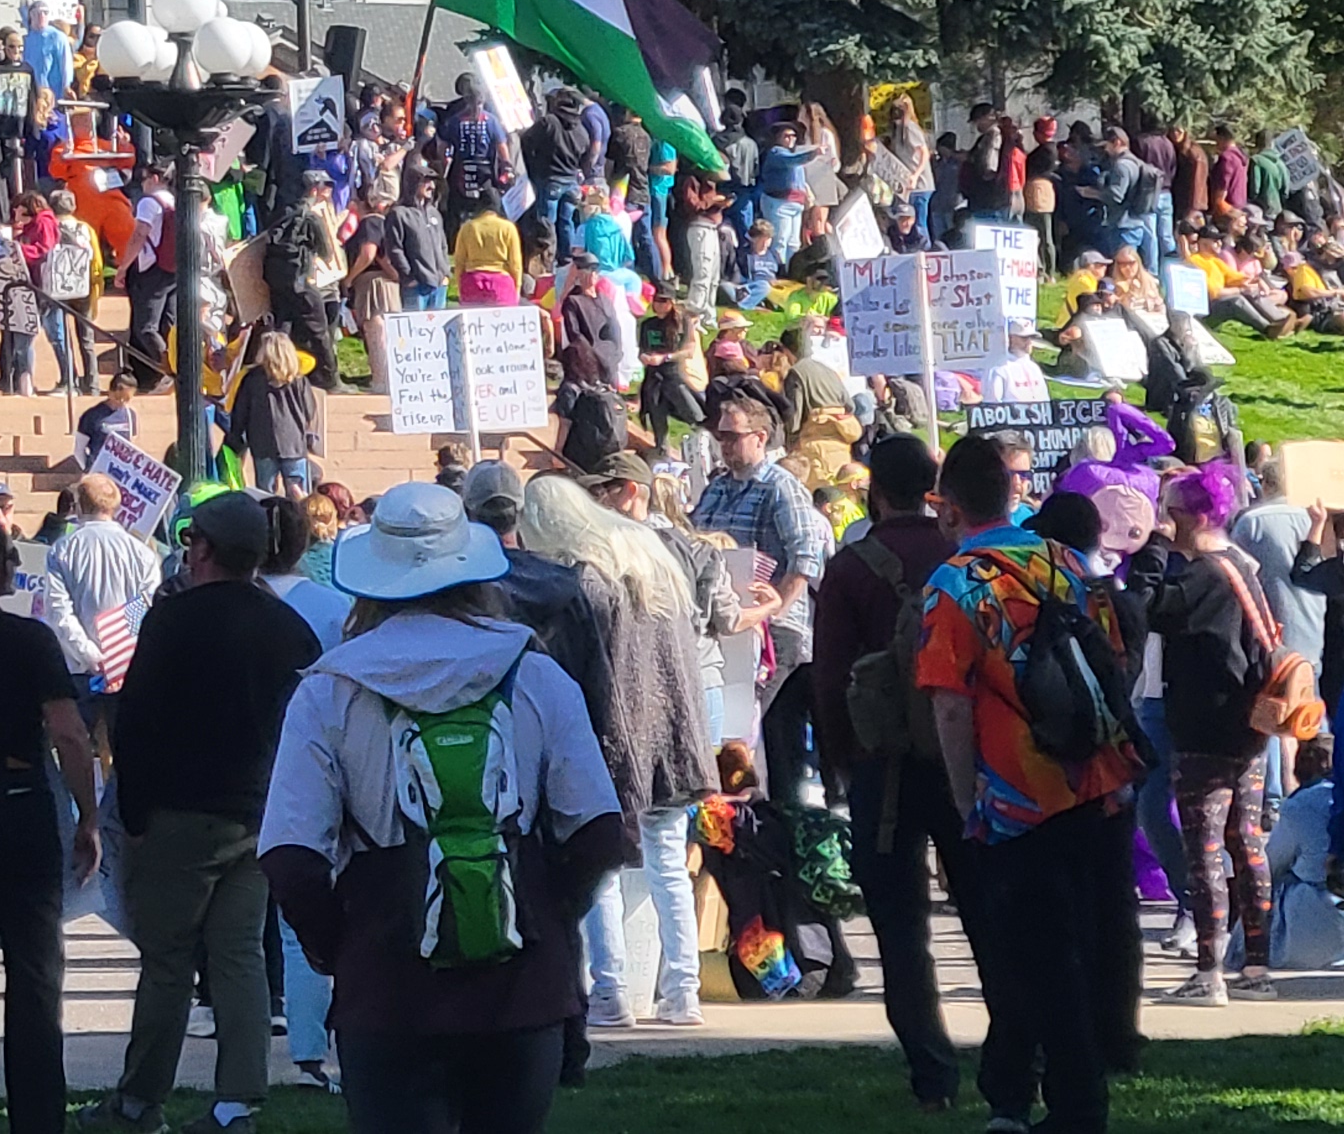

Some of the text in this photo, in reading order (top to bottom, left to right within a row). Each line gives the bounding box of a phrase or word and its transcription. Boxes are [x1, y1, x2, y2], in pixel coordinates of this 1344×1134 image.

[990, 228, 1024, 250] THE
[925, 253, 993, 284] Johnson
[1005, 287, 1032, 306] THE
[388, 315, 436, 344] They
[490, 320, 516, 338] you
[518, 315, 538, 335] to
[932, 329, 991, 356] THAT
[475, 364, 495, 376] ook
[969, 400, 1109, 429] ABOLISH ICE
[141, 460, 176, 493] HATE
